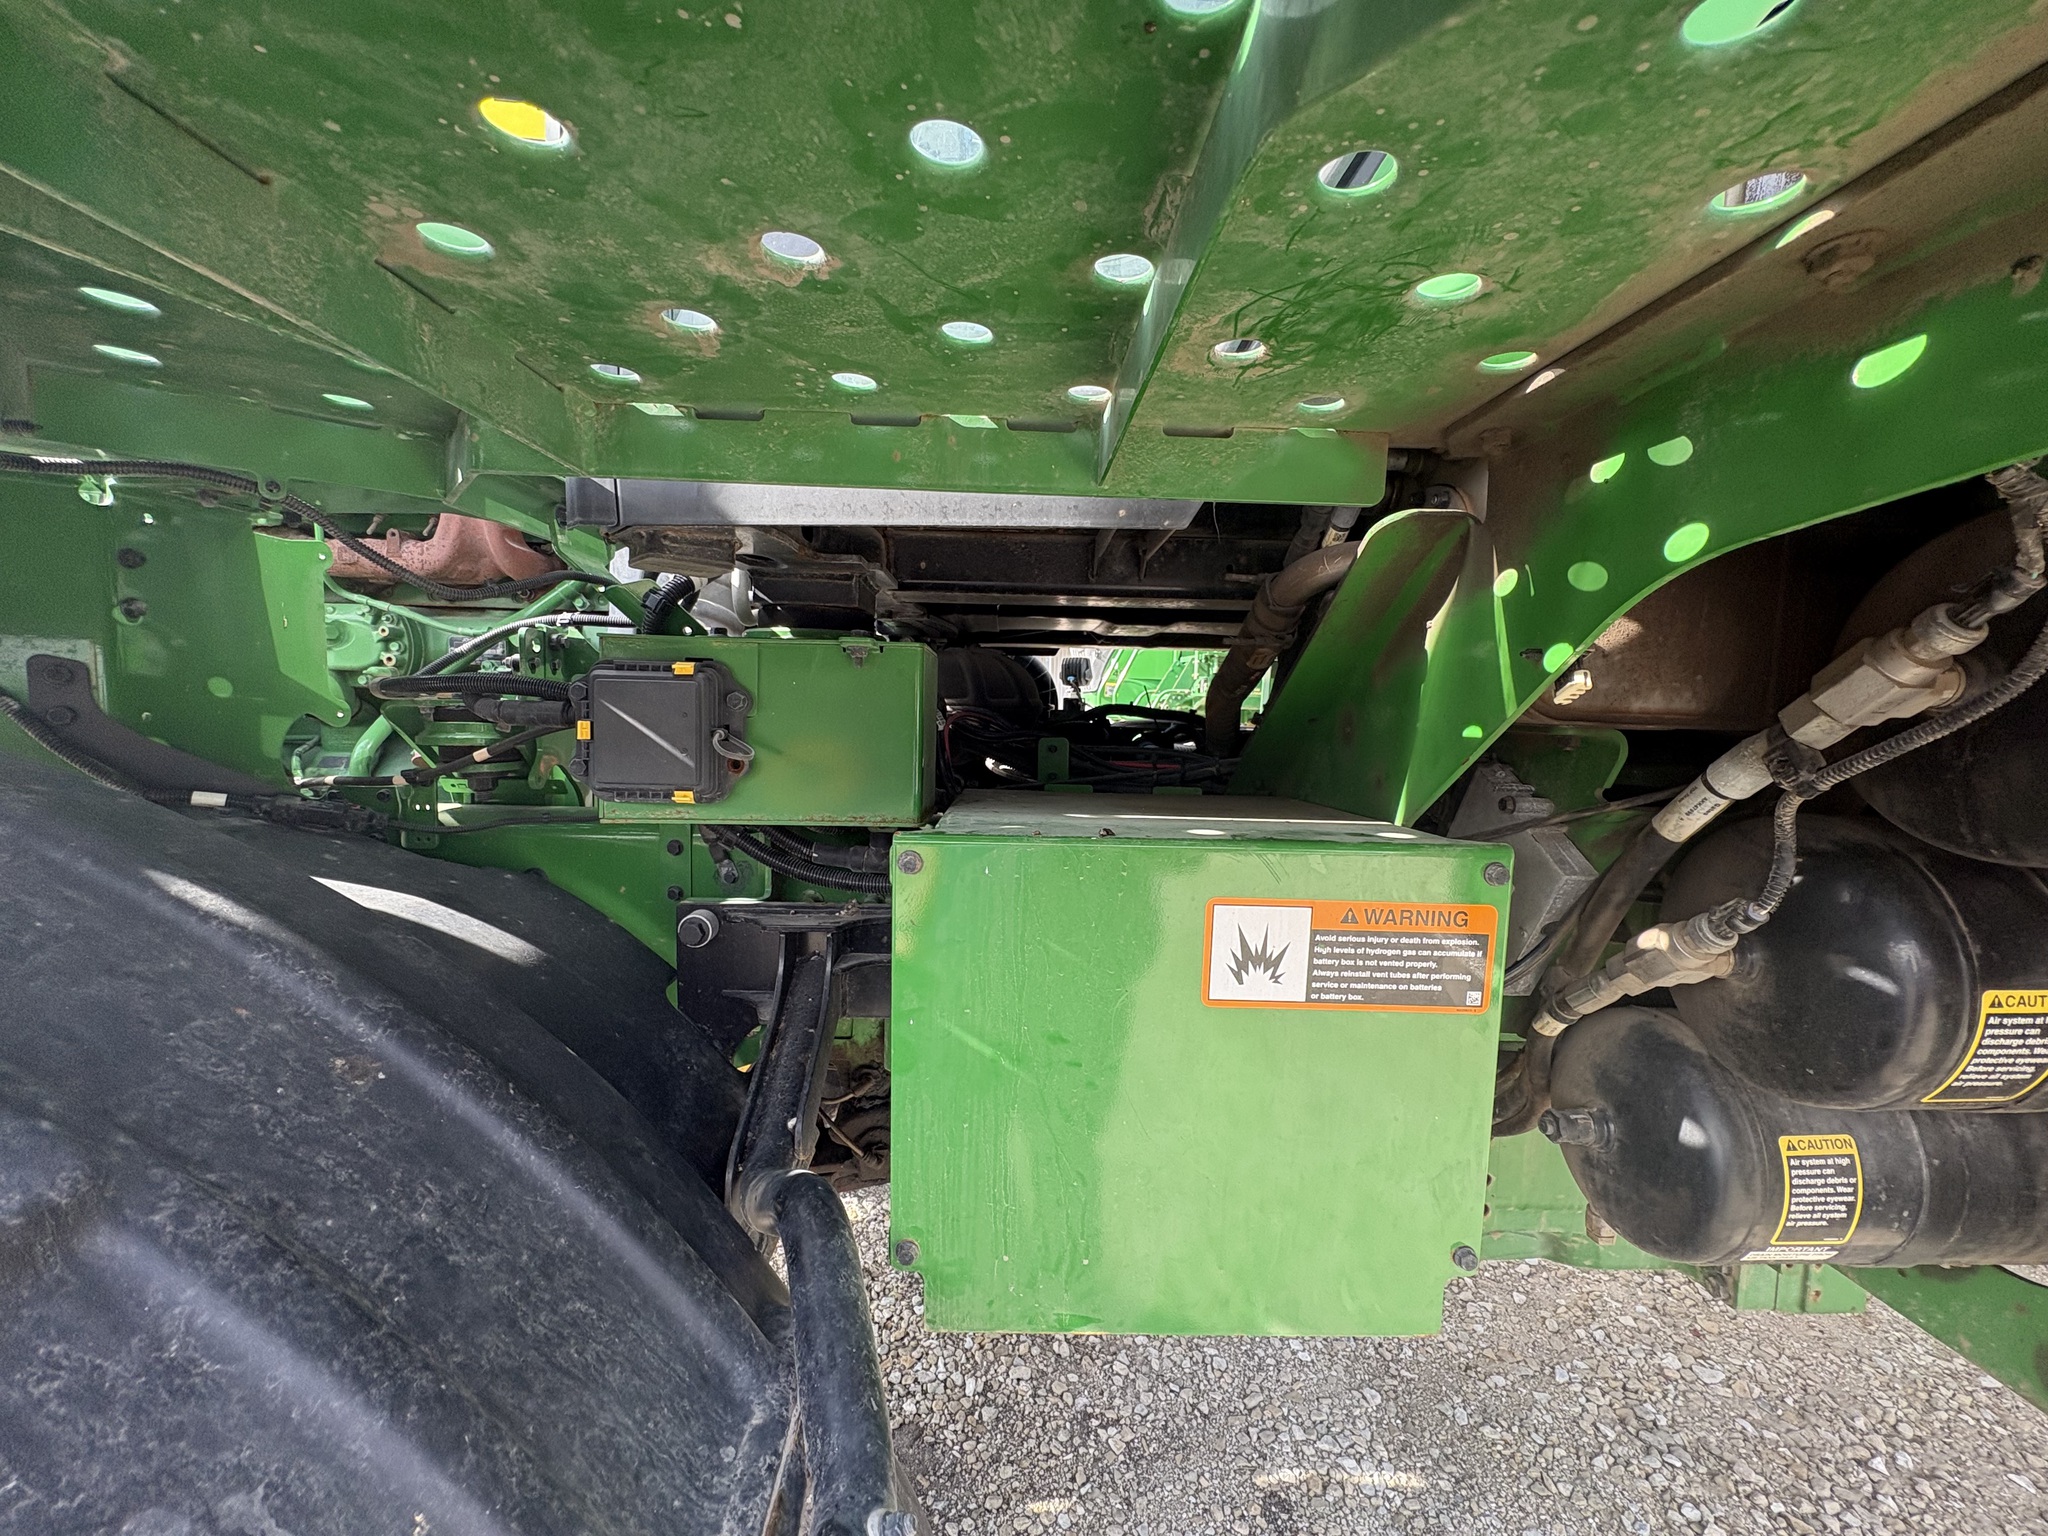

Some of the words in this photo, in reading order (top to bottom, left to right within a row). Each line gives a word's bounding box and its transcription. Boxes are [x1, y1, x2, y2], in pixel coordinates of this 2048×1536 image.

[1364, 908, 1468, 928] WARNING
[1368, 936, 1389, 944] injury
[1442, 938, 1479, 946] explosion.
[1314, 946, 1331, 954] High
[1366, 948, 1400, 956] hydrogen
[1313, 958, 1339, 966] battery
[1312, 970, 1338, 978] Always
[1341, 970, 1370, 978] reinstall
[1431, 973, 1471, 981] performing
[1321, 993, 1346, 1001] battery
[2002, 1017, 2033, 1026] system
[1984, 1028, 2023, 1037] pressure
[1981, 1038, 2024, 1047] discharge
[1797, 1138, 1853, 1150] CAUTION
[1790, 1158, 1800, 1166] Air
[1802, 1158, 1826, 1167] system
[1835, 1157, 1850, 1166] high
[1791, 1168, 1821, 1177] pressure
[1792, 1178, 1825, 1187] discharge
[1792, 1187, 1835, 1195] components.
[1792, 1196, 1825, 1204] protective
[1822, 1212, 1847, 1220] system
